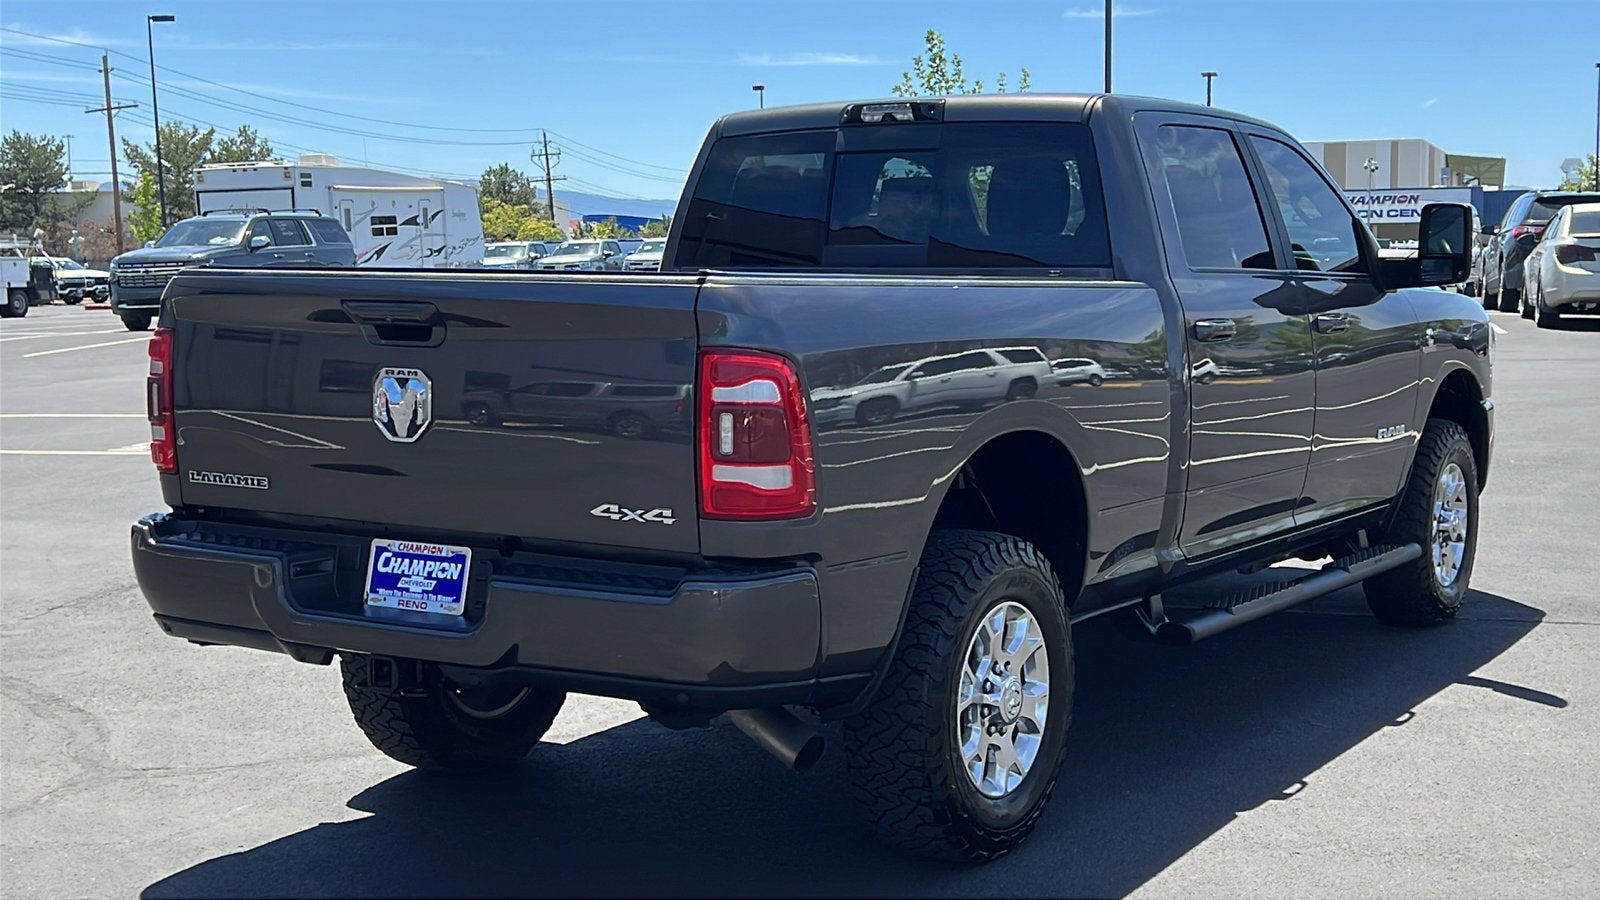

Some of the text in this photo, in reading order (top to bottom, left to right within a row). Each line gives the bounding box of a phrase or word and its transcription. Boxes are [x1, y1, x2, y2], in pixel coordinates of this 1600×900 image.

[385, 369, 419, 377] RAM
[1377, 424, 1406, 439] RAM
[189, 470, 269, 489] LARAMIE
[397, 542, 444, 555] CHAMPION
[400, 578, 434, 588] CHEVROLET
[397, 599, 428, 610] RENO
